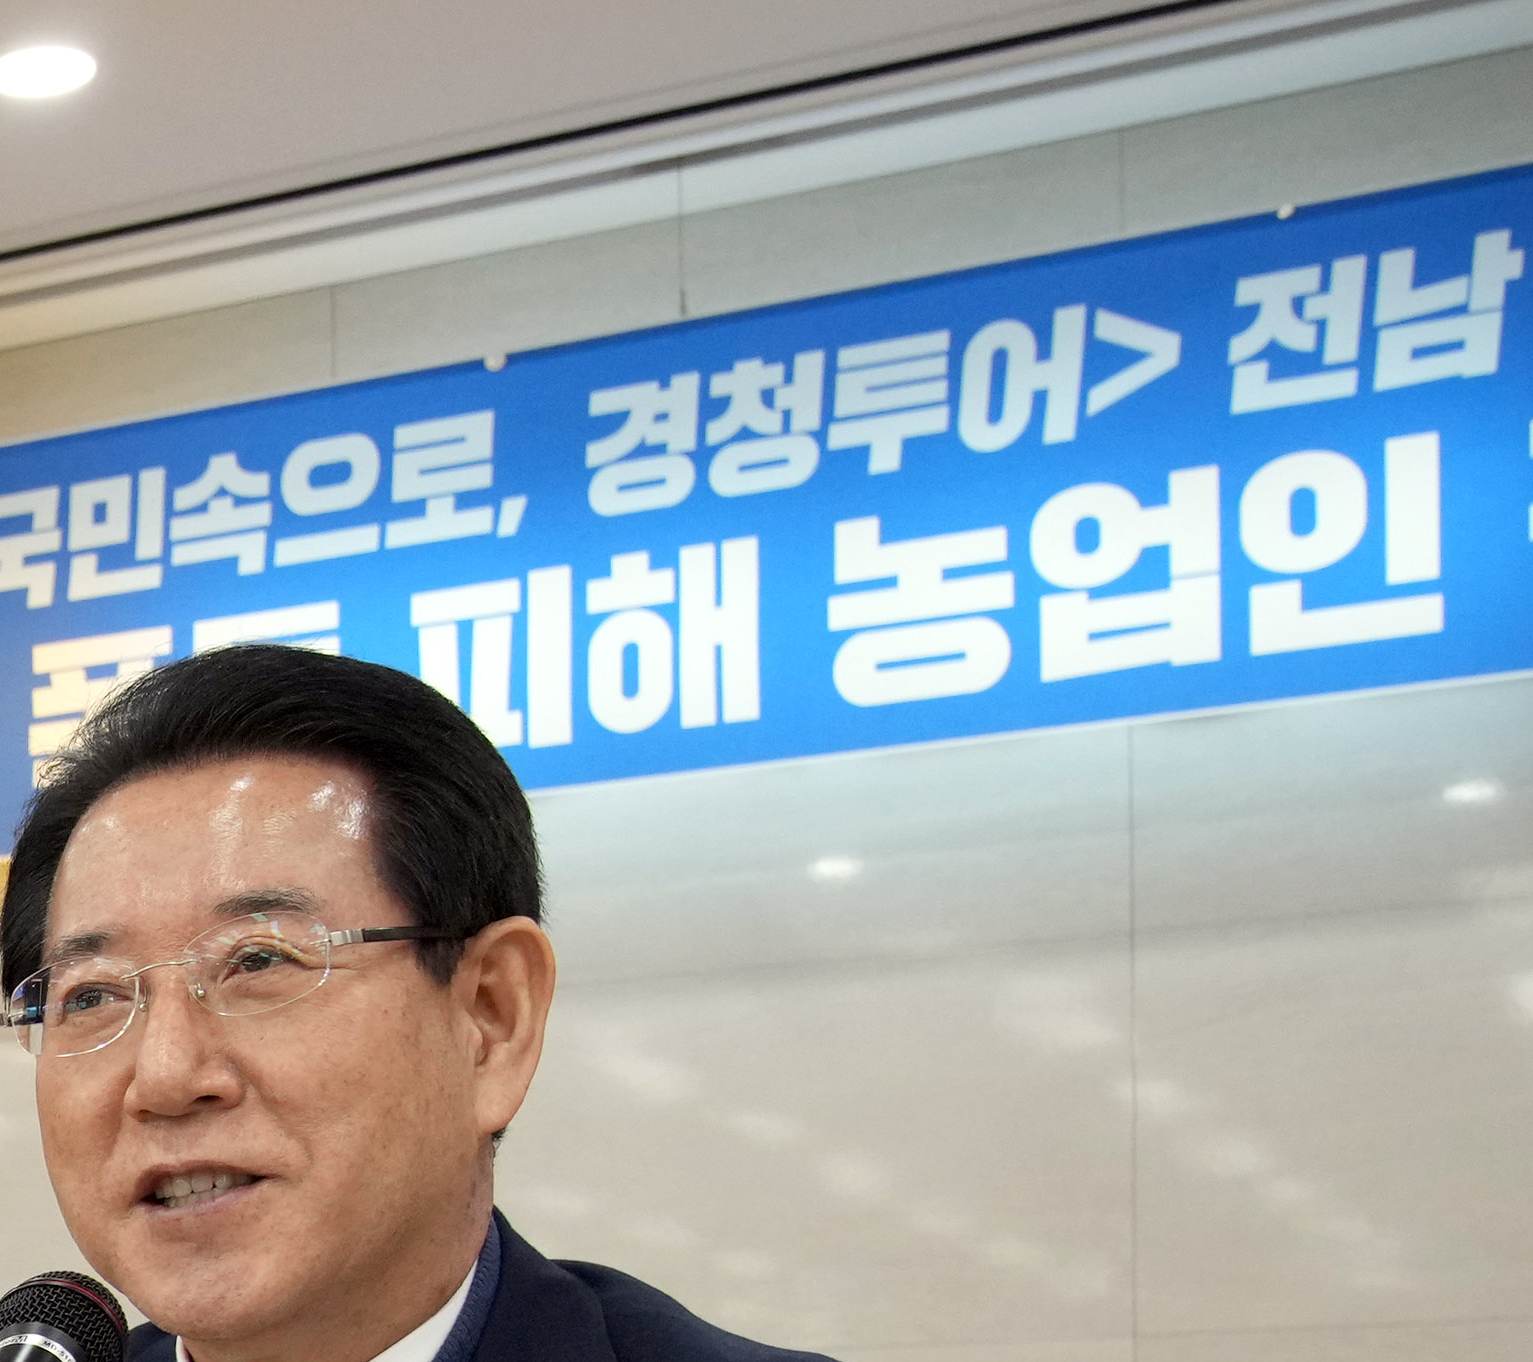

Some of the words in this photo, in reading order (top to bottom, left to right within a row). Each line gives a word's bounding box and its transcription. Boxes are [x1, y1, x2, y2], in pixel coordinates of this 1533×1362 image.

[585, 305, 1182, 517] 경청투어>
[1229, 229, 1524, 414] 전남
[410, 536, 762, 750] 피해
[827, 431, 1446, 708] 농업인
